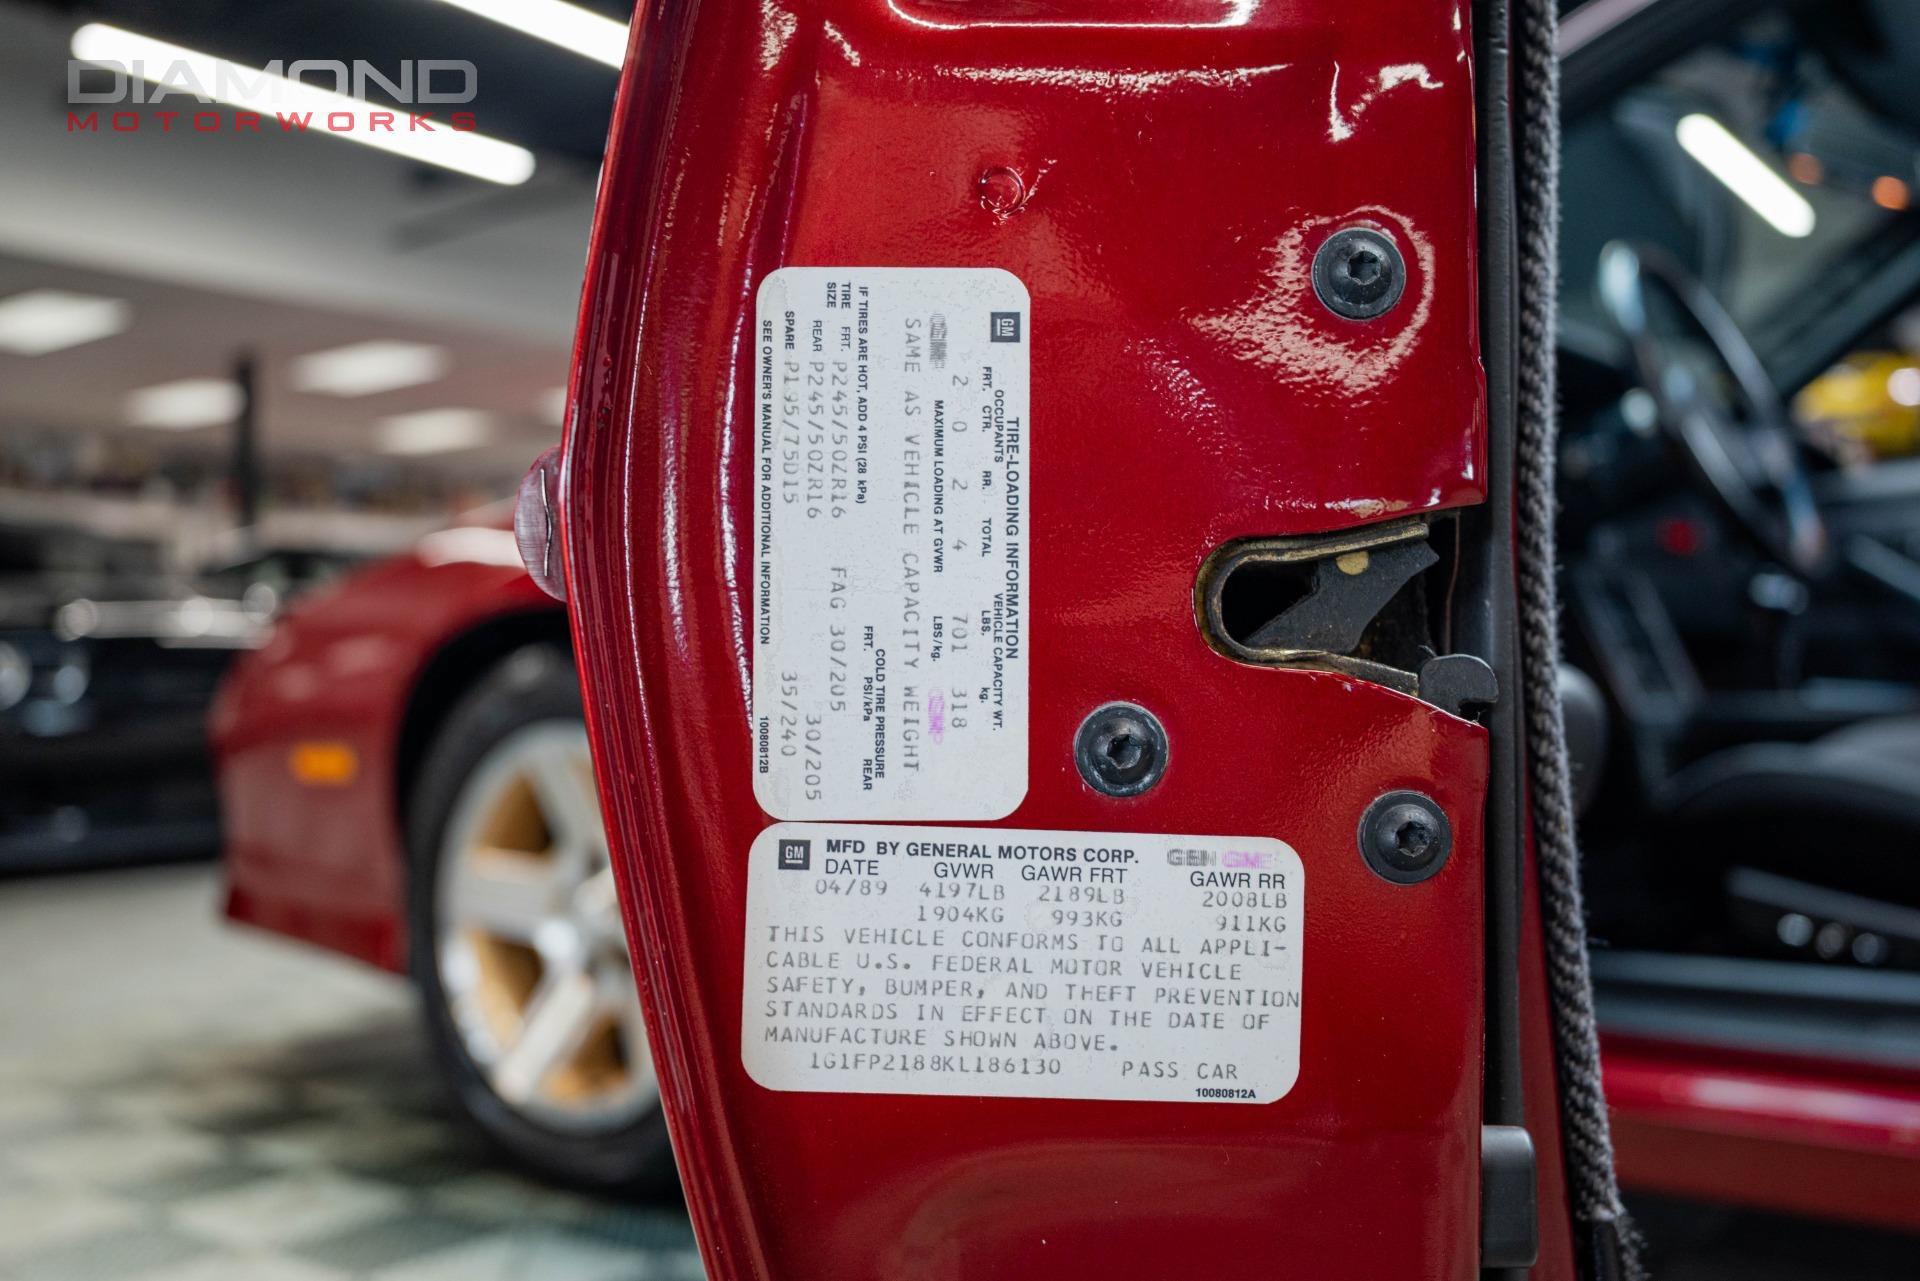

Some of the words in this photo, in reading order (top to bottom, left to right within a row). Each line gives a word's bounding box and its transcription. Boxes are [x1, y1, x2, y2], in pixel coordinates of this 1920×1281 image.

[827, 282, 836, 308] SIZE
[841, 282, 850, 309] TIRE
[858, 286, 868, 297] IF
[762, 320, 772, 342] SEE
[784, 311, 794, 350] SPARE
[858, 300, 868, 334] TIRES
[1001, 318, 1015, 337] GM
[812, 320, 822, 352] REAR
[841, 327, 850, 351] FRT.
[858, 338, 867, 361] ARE
[905, 318, 921, 372] SAME
[762, 346, 772, 400] OWNER'S
[856, 365, 867, 393] HOT,
[951, 375, 969, 387] 2
[982, 366, 992, 391] FRT.
[857, 397, 867, 422] ADD
[905, 391, 921, 416] AS
[982, 405, 991, 432] CTR.
[761, 403, 772, 453] MANUAL
[782, 361, 799, 504] P195/75D15
[807, 361, 824, 519] P245/50ZR16
[831, 361, 848, 519] P245/50ZR16
[934, 400, 943, 457] MAXIMUM
[951, 421, 968, 432] 0
[994, 389, 1004, 462] OCCUPANTS
[857, 435, 867, 454] PSI
[761, 457, 771, 481] FOR
[856, 457, 867, 474] (28
[982, 470, 991, 490] RR.
[1006, 417, 1019, 536] TIRE-LOADING
[856, 480, 867, 504] kPa)
[903, 435, 920, 535] VEHICLE
[933, 461, 943, 515] LOADING
[951, 478, 968, 491] 2
[760, 485, 771, 557] ADDITIONAL
[933, 519, 943, 533] AT
[951, 540, 968, 551] 4
[982, 518, 991, 557] TOTAL
[933, 538, 942, 573] GVWR
[760, 561, 770, 644] INFORMATION
[830, 567, 846, 609] FAG
[1006, 542, 1018, 659] INFORMATION
[902, 552, 920, 669] CAPACITY
[981, 610, 990, 635] LBS.
[994, 593, 1002, 643] VEHICLE
[864, 626, 873, 651] FRT.
[931, 616, 942, 662] LBS/kg.
[951, 614, 968, 653] 701
[829, 624, 846, 712] 30/205
[875, 649, 885, 682] COLD
[993, 647, 1002, 706] CAPACITY
[863, 676, 872, 721] PSI/kPa
[875, 686, 885, 712] TIRE
[951, 688, 968, 729] 318
[979, 687, 990, 703] kg.
[781, 672, 798, 757] 35/240
[902, 686, 919, 772] WEIGHT
[993, 710, 1002, 731] WT.
[759, 716, 768, 773] 10080812B
[805, 714, 822, 801] 30/205
[875, 716, 885, 778] PRESSURE
[863, 759, 872, 791] REAR
[785, 845, 804, 860] GM
[826, 840, 865, 853] MFD
[877, 842, 899, 855] BY
[906, 842, 991, 859] GENERAL
[998, 846, 1077, 861] MOTORS
[1083, 848, 1139, 864] CORP.
[825, 859, 879, 876] DATE
[934, 863, 994, 879] GVWR
[1021, 865, 1082, 882] GAWR
[1090, 867, 1128, 884] FRT
[1190, 872, 1251, 888] GAWR
[1259, 873, 1285, 889] RR
[815, 879, 887, 895] 04/89
[919, 881, 1005, 901] 4197LB
[1039, 886, 1124, 905] 2189LB
[1202, 890, 1287, 909] 2008LB
[918, 905, 1004, 923] 1904KG
[1052, 910, 1123, 927] 993KG
[1216, 915, 1287, 932] 911KG
[767, 925, 824, 943] THIS
[845, 927, 945, 946] VEHICLE
[962, 930, 1078, 951] CONFORMS
[1100, 934, 1123, 952] TO
[1142, 937, 1180, 954] ALL
[1200, 939, 1288, 957] APPLI-
[766, 951, 840, 969] CABLE
[857, 953, 911, 970] U.S.
[932, 955, 1033, 973] FEDERAL
[1050, 959, 1122, 976] MOTOR
[1141, 962, 1242, 980] VEHICLE
[766, 976, 867, 996] SAFETY,
[885, 979, 985, 999] BUMPER,
[1006, 981, 1048, 999] AND
[1066, 983, 1137, 1002] THEFT
[1156, 987, 1300, 1008] PREVENTION
[765, 1001, 898, 1020] STANDARDS
[918, 1004, 943, 1021] IN
[962, 1005, 1046, 1024] EFFECT
[1064, 1008, 1092, 1026] ON
[1110, 1010, 1152, 1028] THE
[1169, 1012, 1225, 1029] DATE
[1243, 1014, 1270, 1030] OF
[765, 1026, 927, 1045] MANUFACTURE
[944, 1031, 1016, 1048] SHOWN
[1034, 1033, 1118, 1051] ABOVE.
[811, 1052, 1061, 1075] 1G1FP2188KL186130
[1122, 1061, 1178, 1079] PASS
[1197, 1063, 1238, 1080] CAR
[1196, 1088, 1256, 1099] 10080812A
